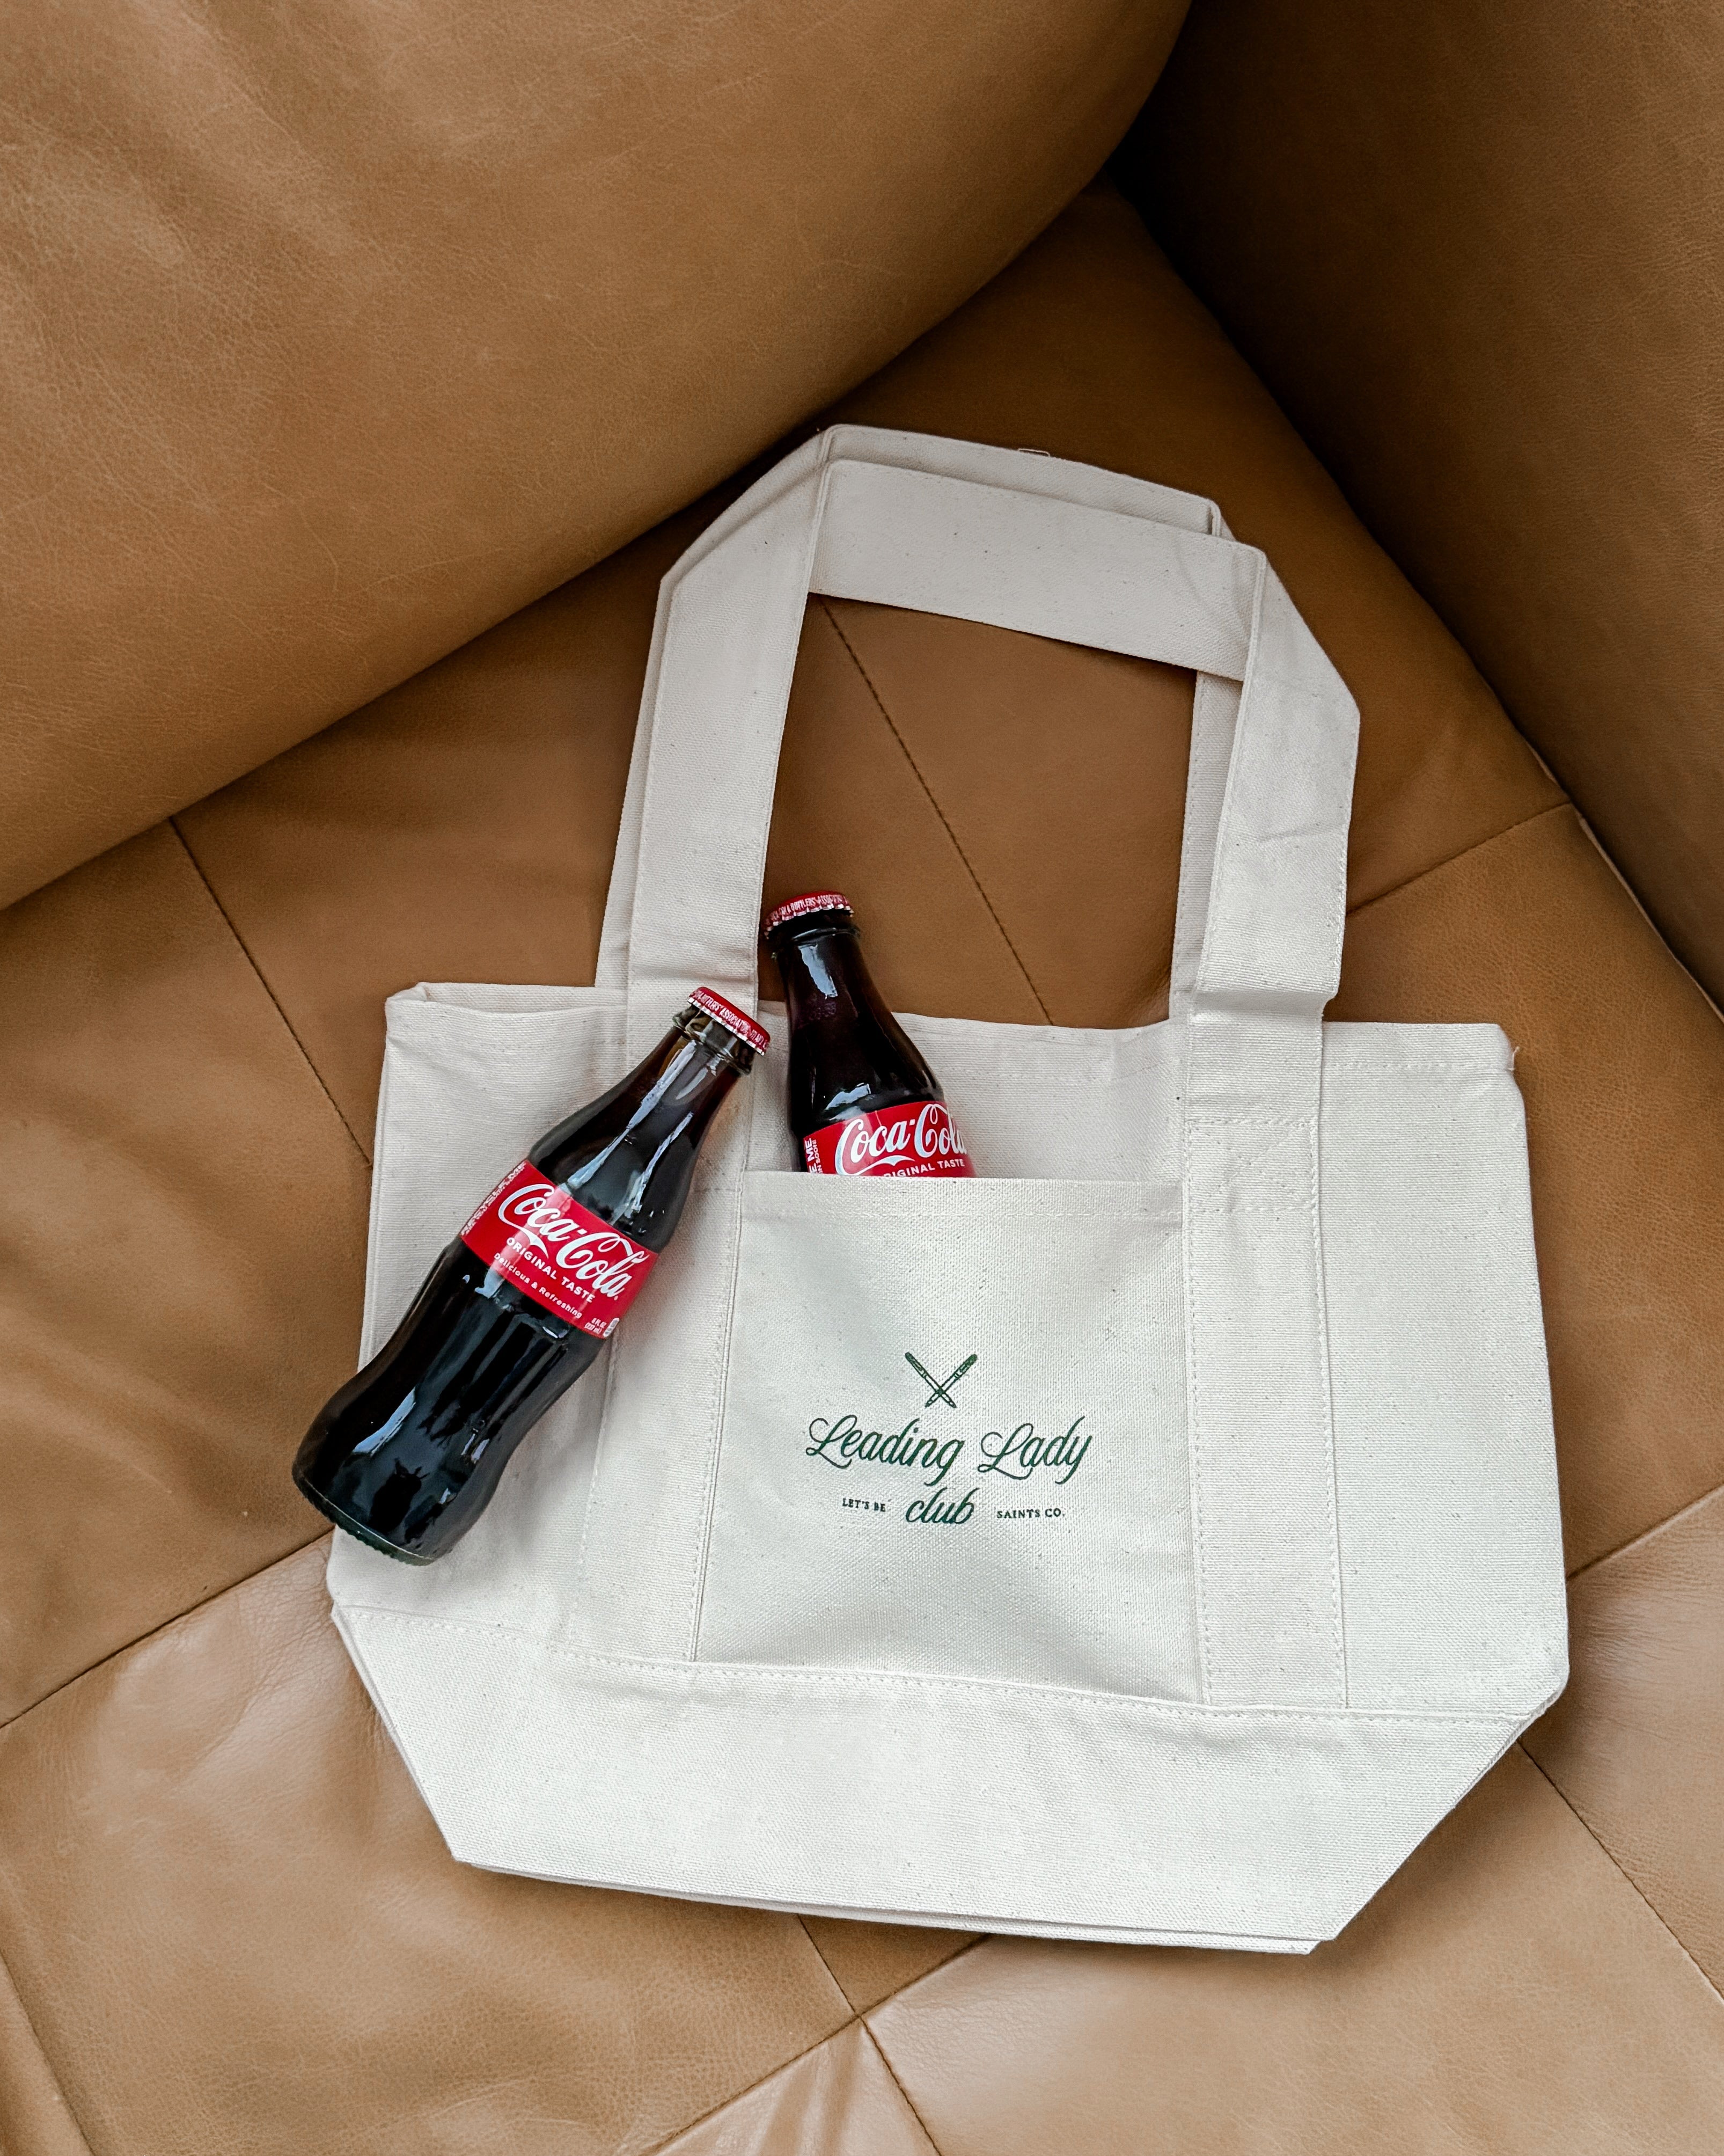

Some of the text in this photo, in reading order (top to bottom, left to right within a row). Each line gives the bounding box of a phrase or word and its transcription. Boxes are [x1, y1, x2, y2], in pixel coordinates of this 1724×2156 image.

[805, 1137, 815, 1162] ME
[937, 1159, 965, 1169] TASTE
[498, 1183, 650, 1299] Coca-Cola
[494, 1252, 582, 1319] Delicious & Refreshing
[506, 1237, 596, 1303] ORIGINAL TASTE
[805, 1414, 1093, 1487] Leading Lady
[842, 1498, 886, 1512] LET'S BE
[905, 1487, 980, 1524] club
[996, 1508, 1040, 1519] SAINTS
